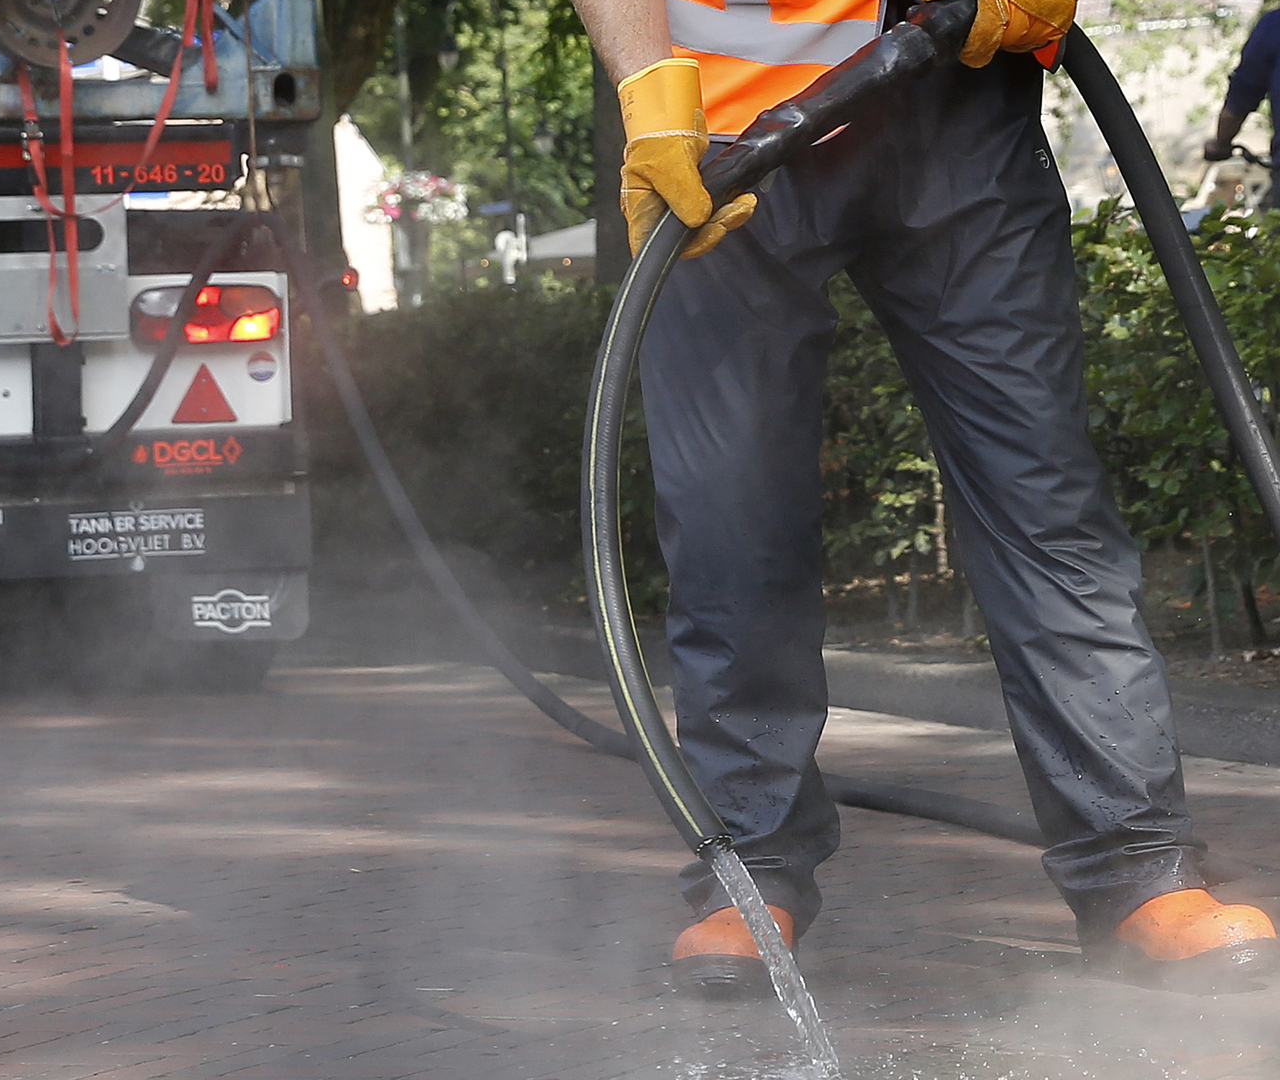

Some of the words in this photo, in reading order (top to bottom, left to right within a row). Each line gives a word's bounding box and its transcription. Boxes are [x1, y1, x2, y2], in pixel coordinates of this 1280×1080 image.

[153, 439, 223, 463] DGCL
[68, 515, 135, 535] TANKER
[138, 512, 205, 532] SERVICE
[192, 601, 271, 621] PACTON
